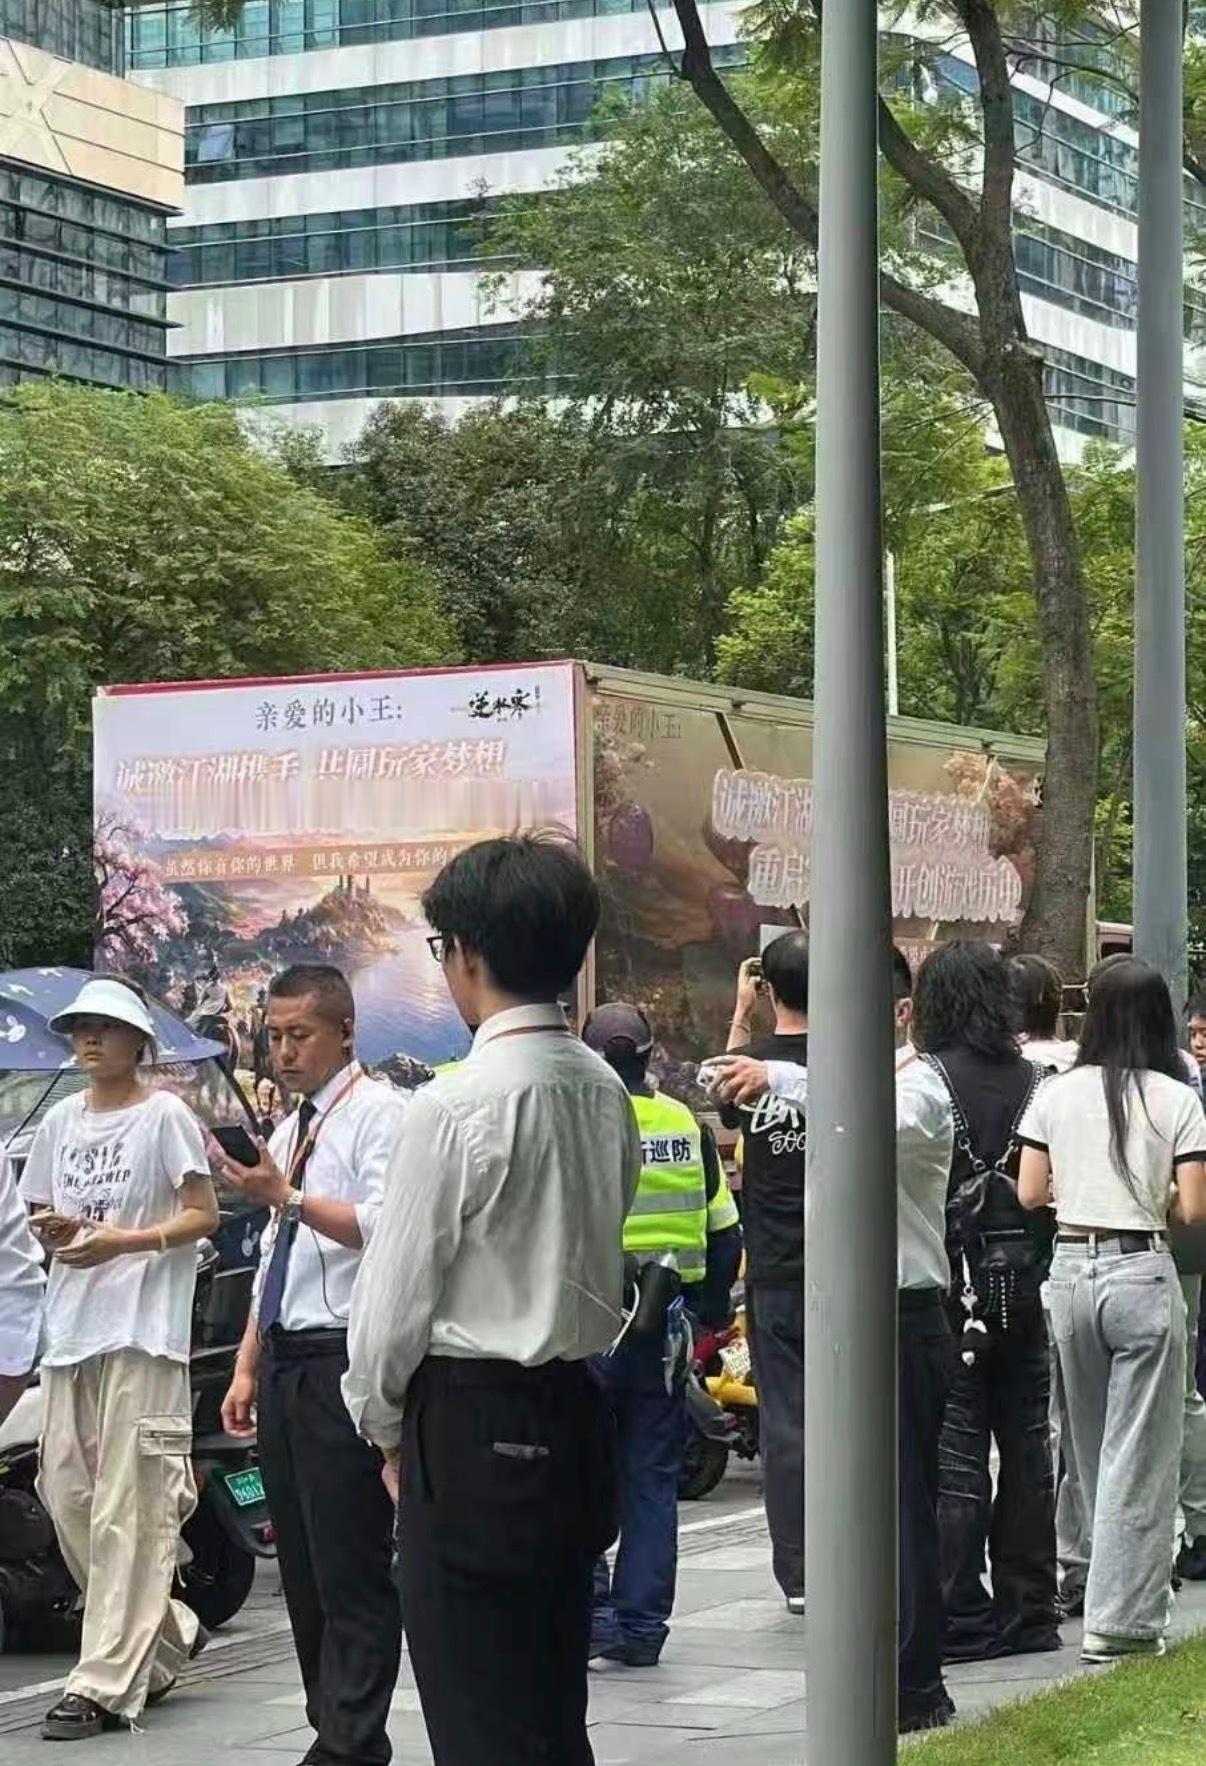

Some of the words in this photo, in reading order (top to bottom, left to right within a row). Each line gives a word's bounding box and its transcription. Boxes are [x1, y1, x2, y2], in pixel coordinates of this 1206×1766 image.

[255, 694, 402, 731] 亲爱的小王：
